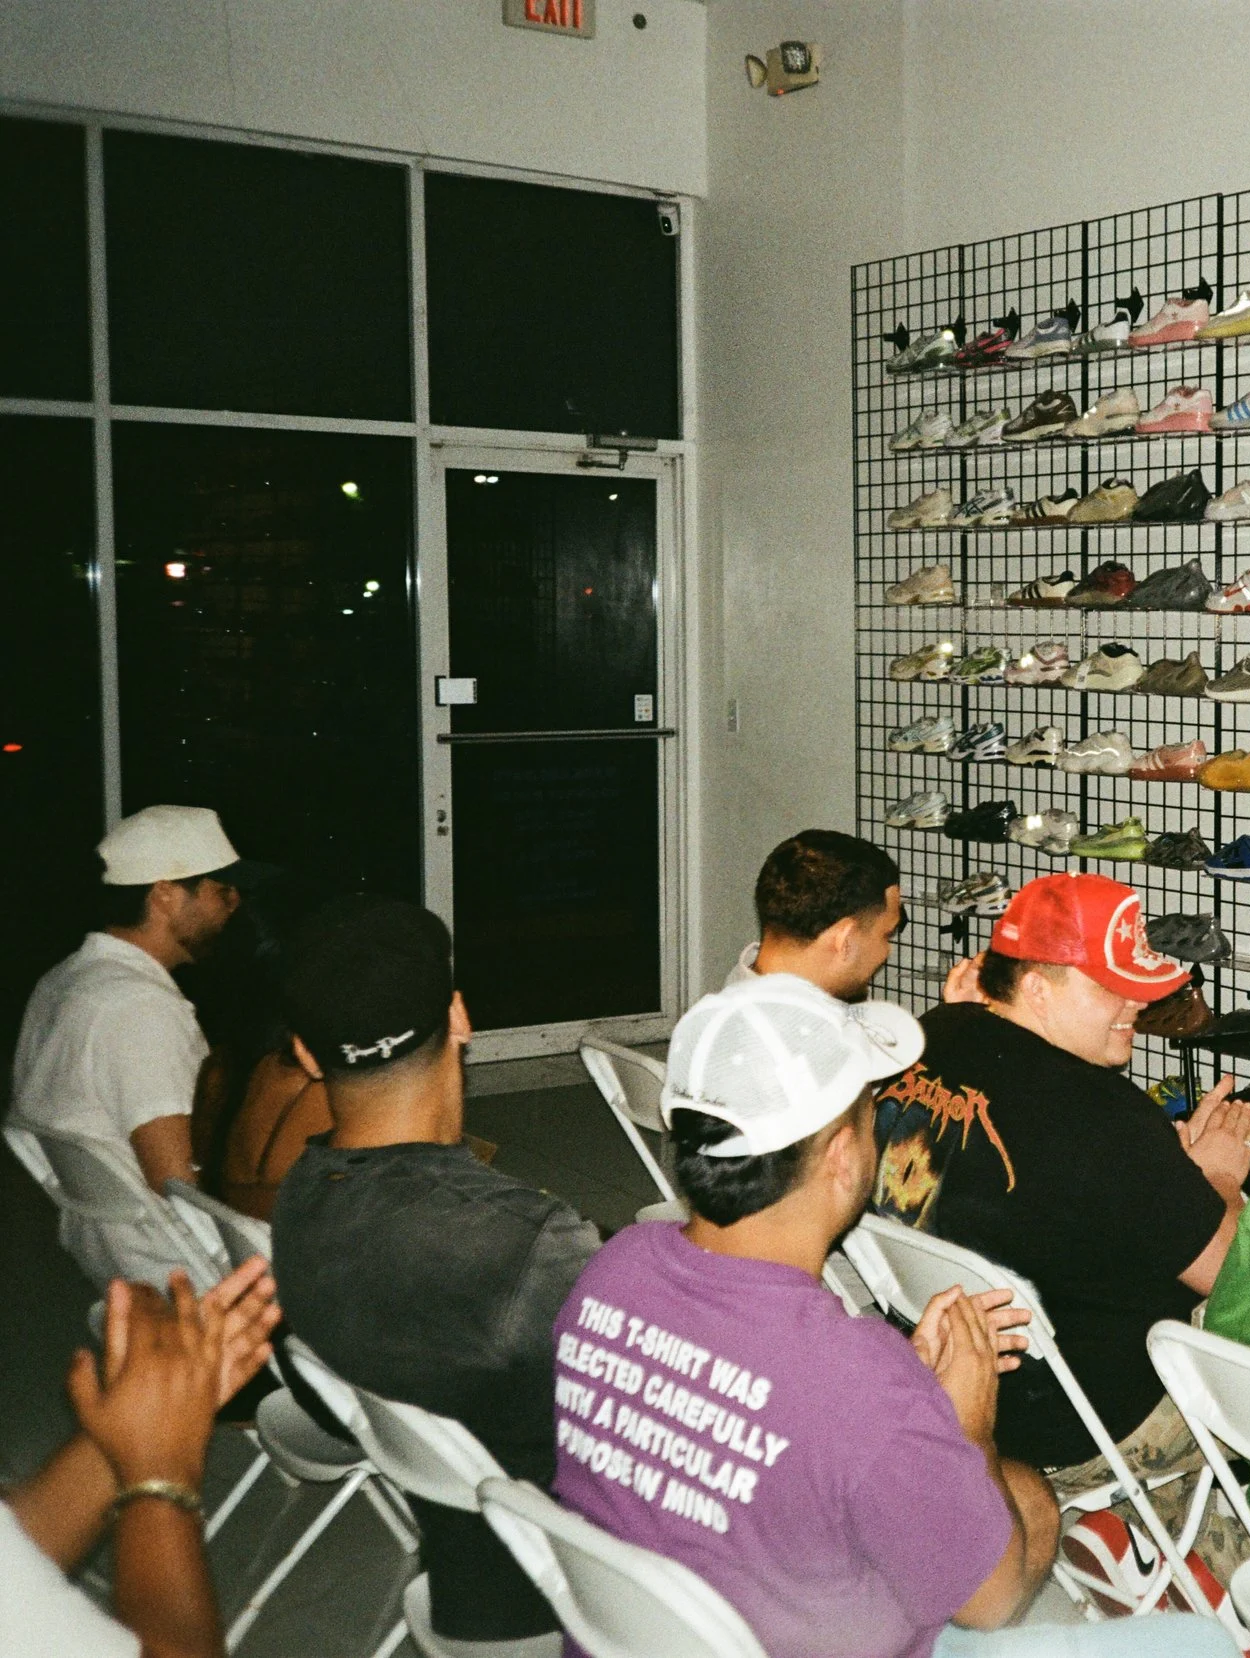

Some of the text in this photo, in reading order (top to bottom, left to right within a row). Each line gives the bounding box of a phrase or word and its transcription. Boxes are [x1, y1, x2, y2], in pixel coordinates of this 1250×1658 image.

[525, 0, 583, 29] EXIT
[578, 1298, 772, 1409] THIS T-SHIRT WAS
[594, 1397, 613, 1428] A
[614, 1405, 759, 1502] PARTICULAR
[644, 1377, 788, 1465] CAREFULLY
[633, 1466, 663, 1501] IN
[661, 1479, 728, 1532] MIND
